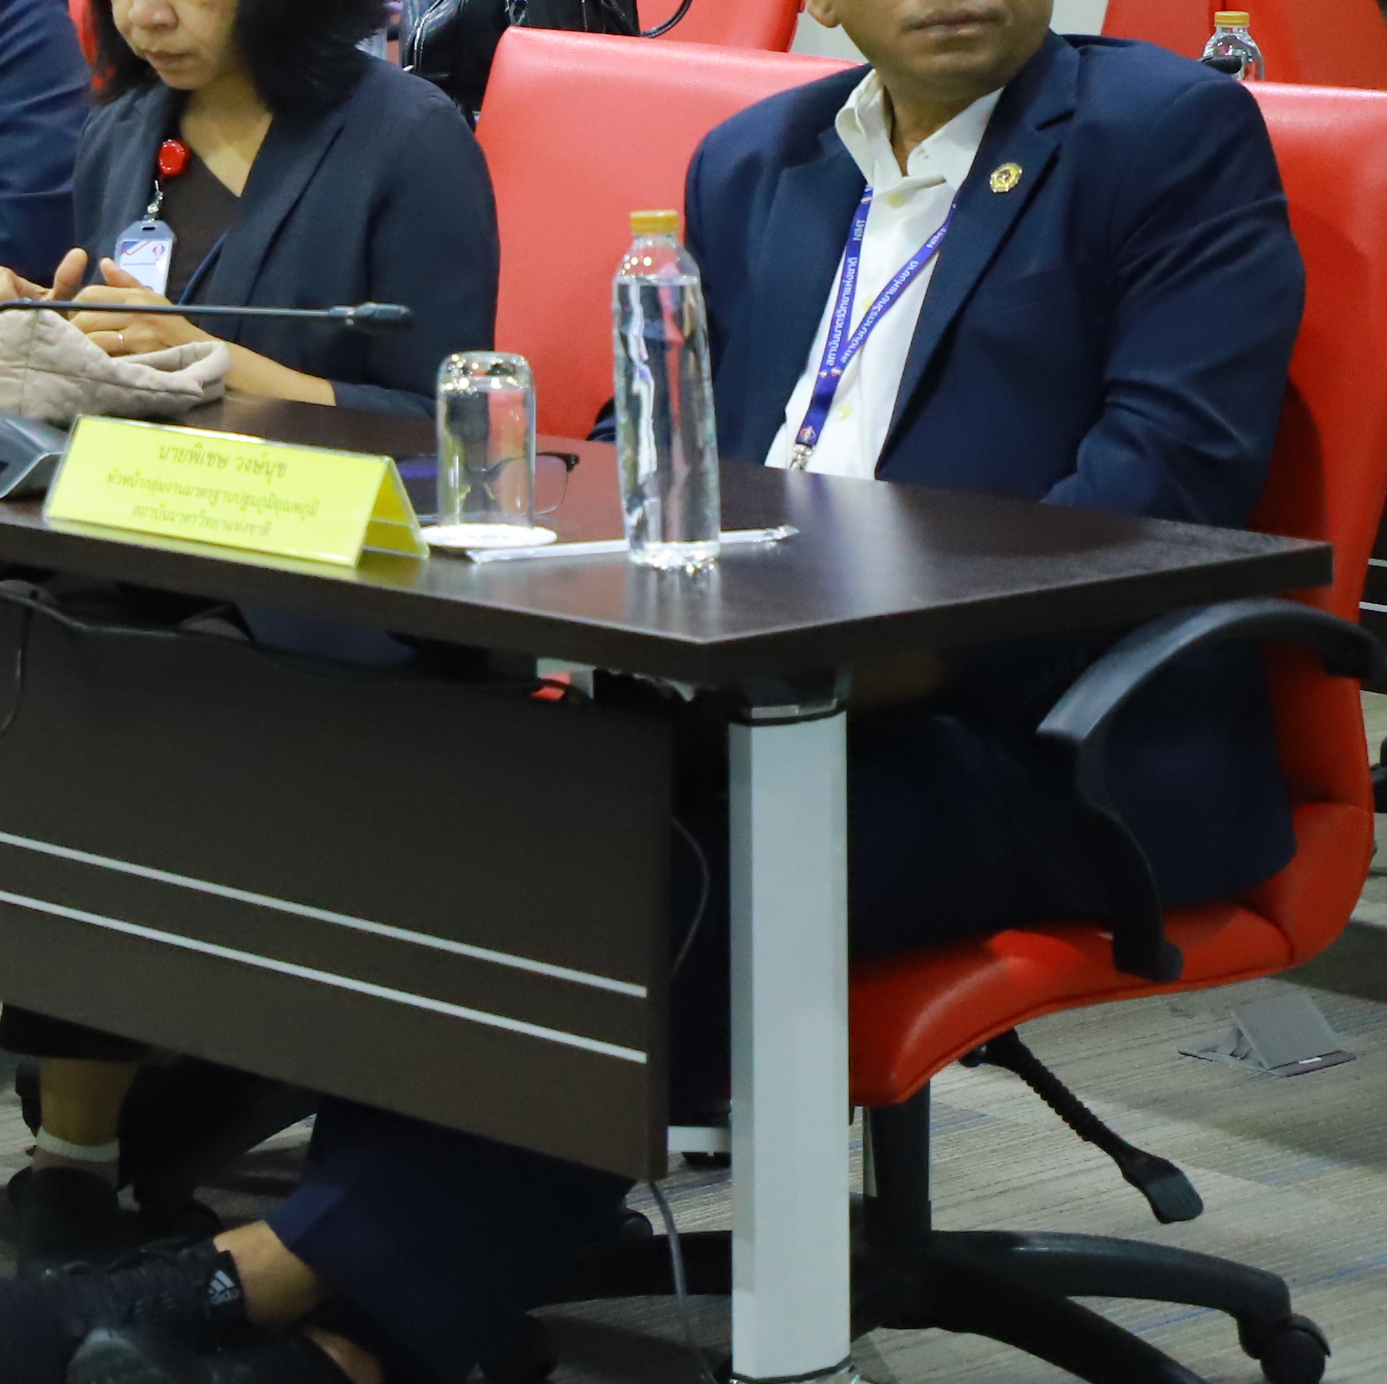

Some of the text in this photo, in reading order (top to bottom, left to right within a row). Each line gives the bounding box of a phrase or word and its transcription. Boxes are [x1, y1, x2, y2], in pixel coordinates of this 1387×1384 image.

[852, 218, 866, 242] NIMT
[926, 226, 949, 249] NIMT
[827, 256, 858, 367] สถาบันมาตรวิทยาแห่งชาติ
[839, 259, 920, 364] สถาบันมาตรวิทยาแห่งชาติ
[131, 503, 273, 538] สถาบันมาตรวิทยาแห่งชาติ
